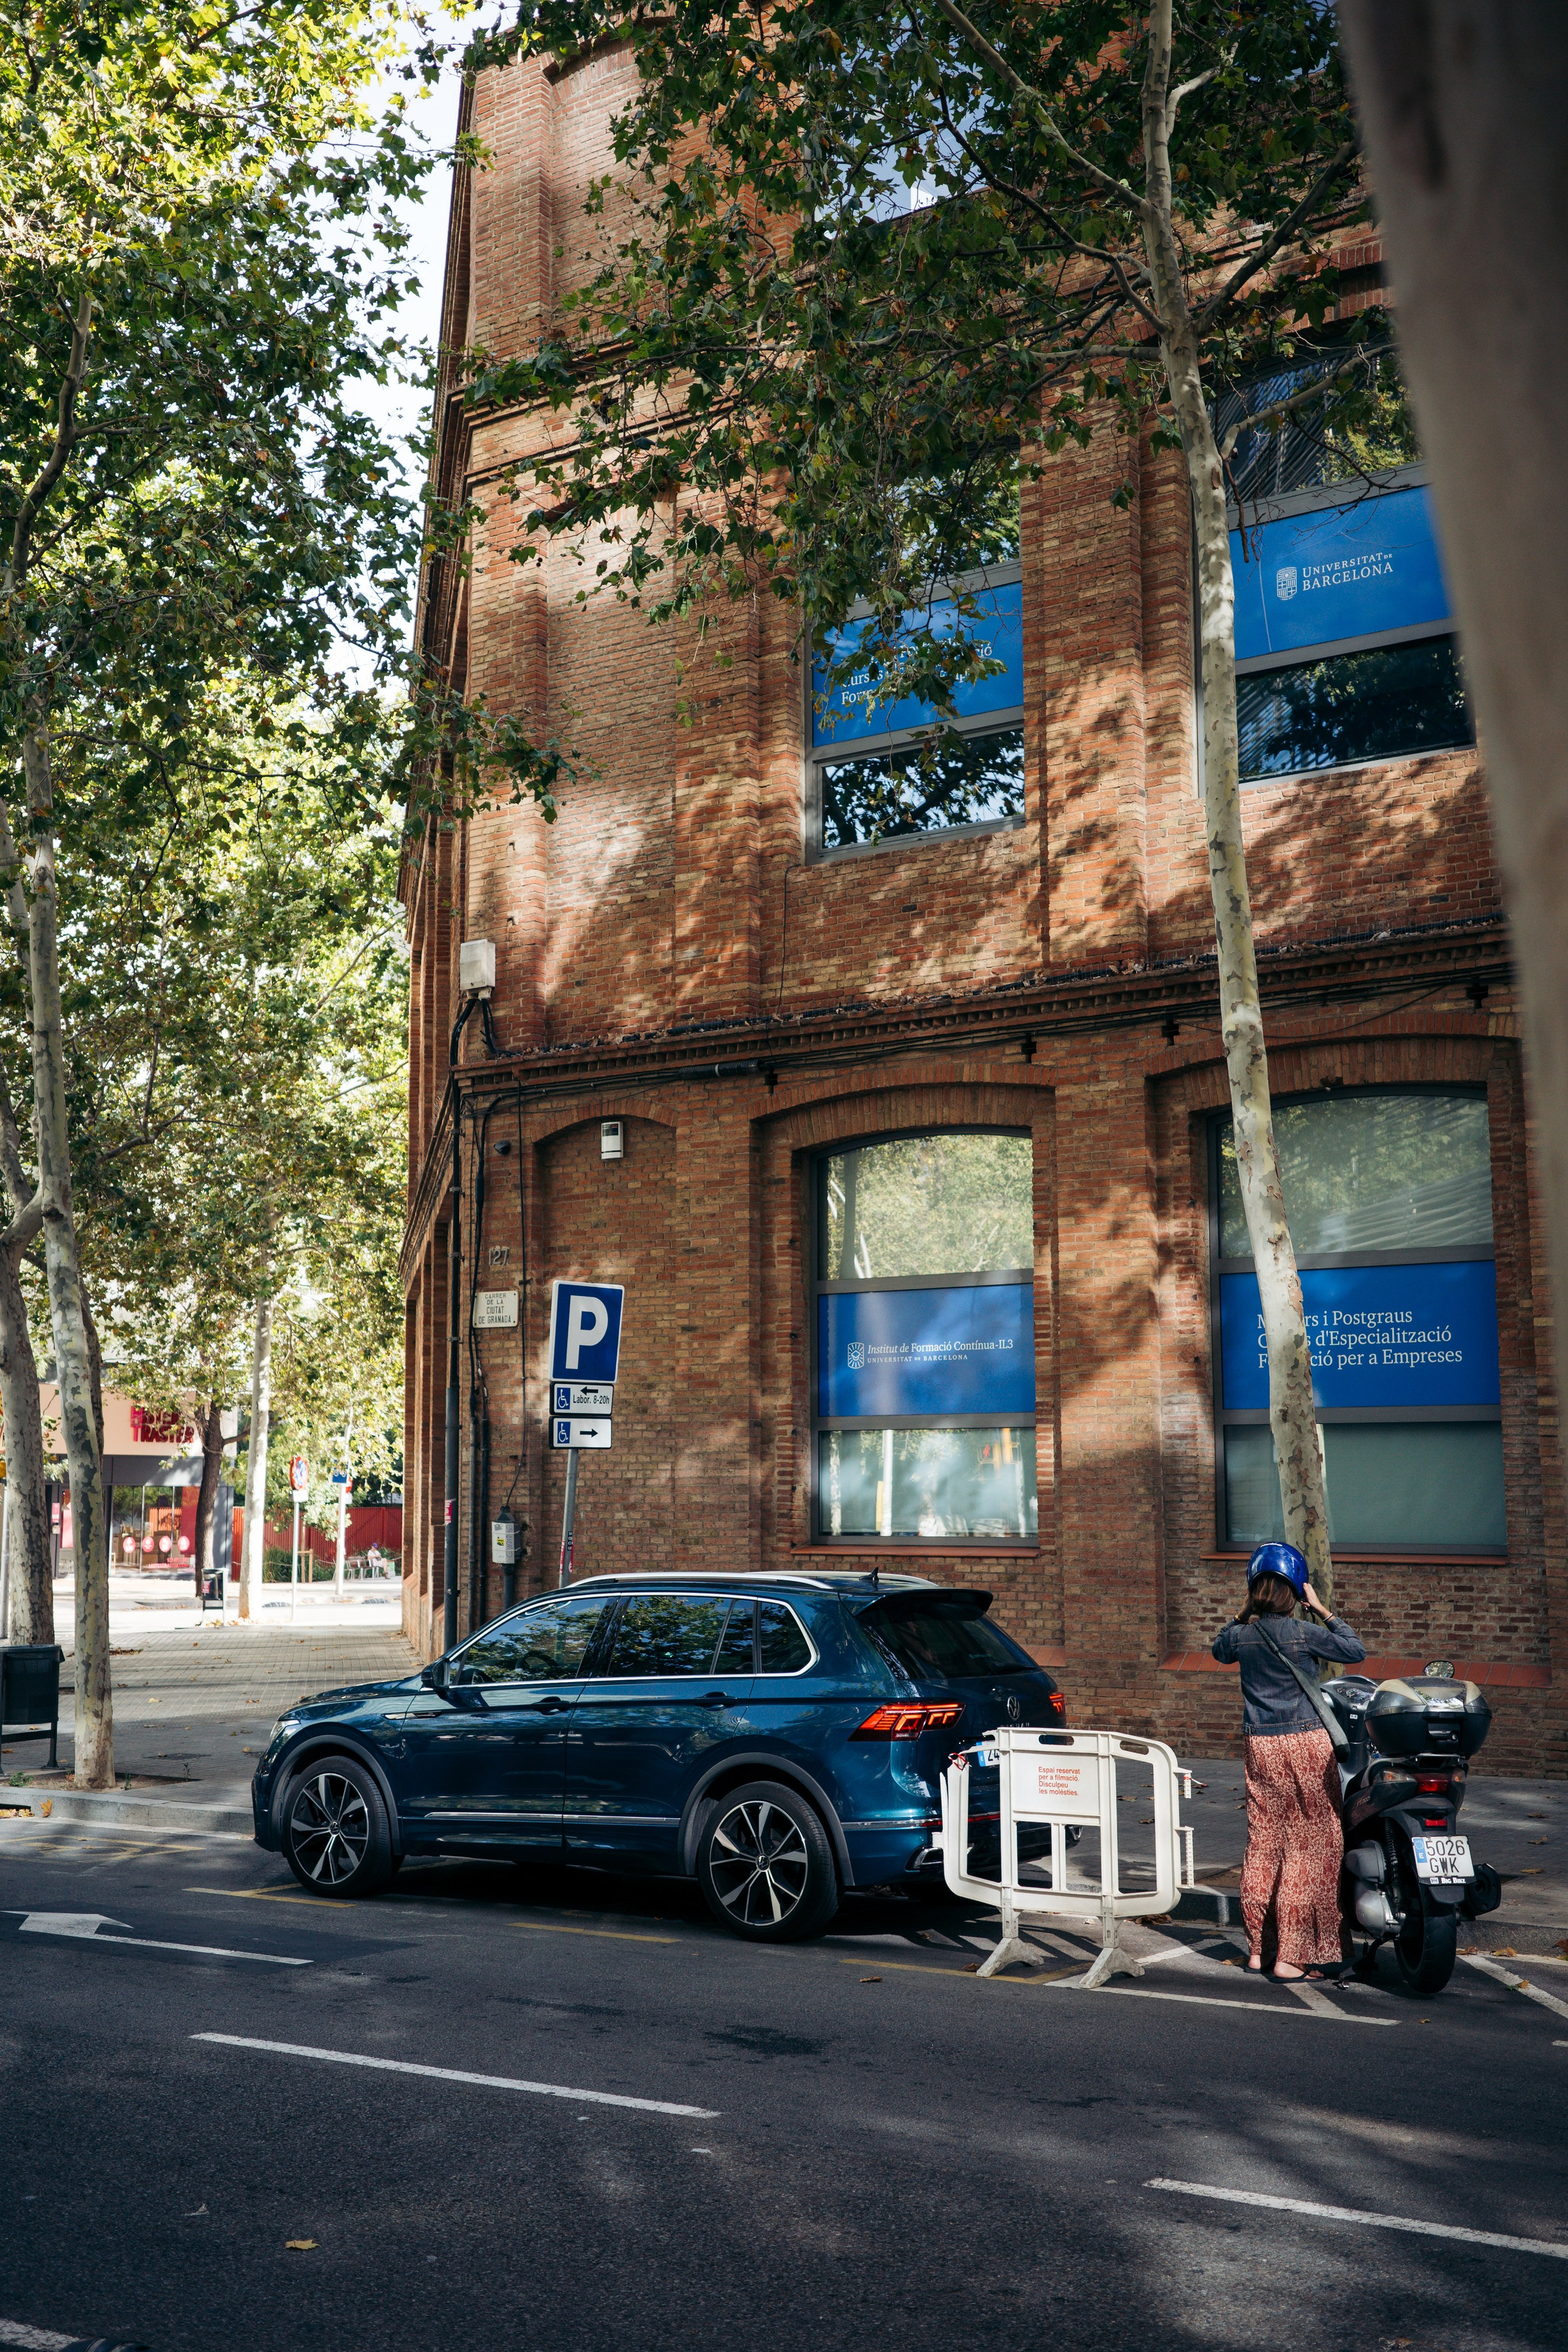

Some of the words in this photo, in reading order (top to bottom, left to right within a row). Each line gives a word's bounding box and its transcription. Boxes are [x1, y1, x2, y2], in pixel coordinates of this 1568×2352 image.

[1302, 552, 1383, 578] UNIVERSITAT
[1302, 562, 1393, 591] BARCELONA
[488, 1246, 510, 1266] 127
[486, 1306, 504, 1314] CIUTAT
[1323, 1310, 1329, 1325] i
[1332, 1310, 1412, 1328] Postgraus
[488, 1315, 511, 1324] GRANADA
[565, 1295, 608, 1370] P
[1316, 1325, 1452, 1349] d'Especialització
[867, 1344, 898, 1354] Institut
[900, 1343, 910, 1352] de
[911, 1341, 952, 1352] Formació
[954, 1339, 1014, 1351] Contínua-IL3
[1257, 1350, 1333, 1368] Fció
[1337, 1353, 1363, 1370] per
[1368, 1354, 1379, 1365] a
[1382, 1349, 1463, 1368] Empreses
[573, 1395, 591, 1404] Labor.
[593, 1395, 609, 1404] 8-20h
[1425, 1840, 1465, 1856] 5026
[1430, 1857, 1460, 1874] GWK
